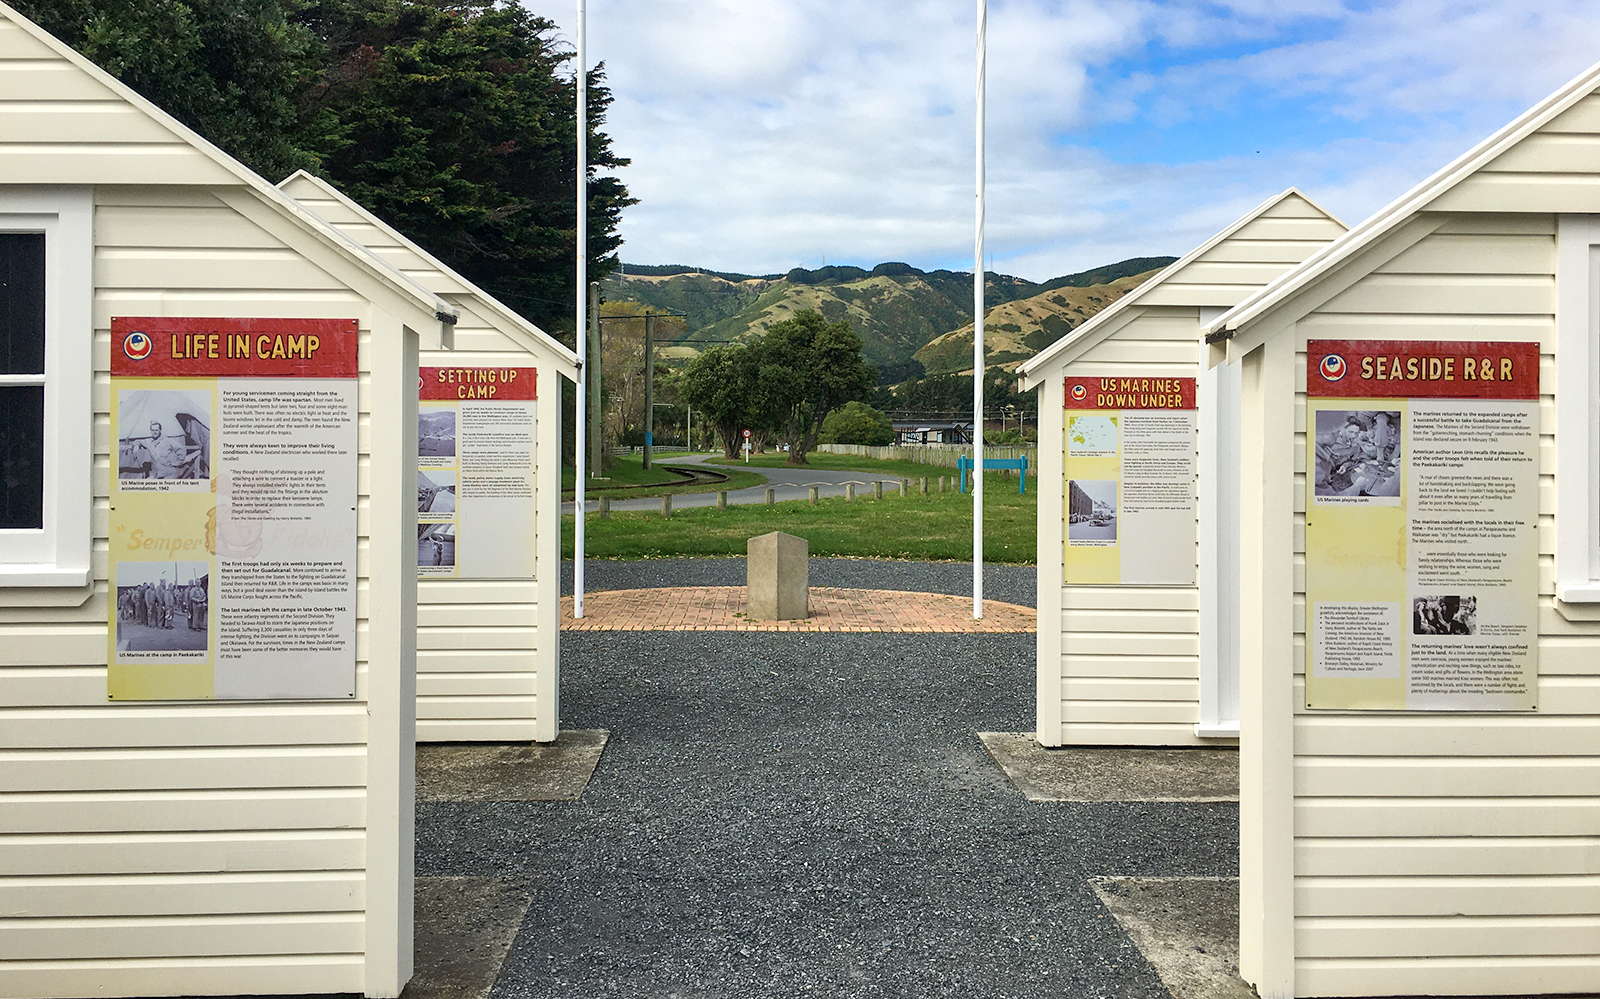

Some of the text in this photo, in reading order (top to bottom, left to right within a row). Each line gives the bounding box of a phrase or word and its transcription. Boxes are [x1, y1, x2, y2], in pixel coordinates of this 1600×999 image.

[171, 334, 320, 360] LIFE IN CAMP
[1360, 356, 1455, 381] SEASIDE
[438, 369, 517, 383] SETTING UP
[458, 385, 497, 399] CAMP
[1100, 378, 1181, 393] US MARINES
[1097, 394, 1183, 407] DOWN UNDER
